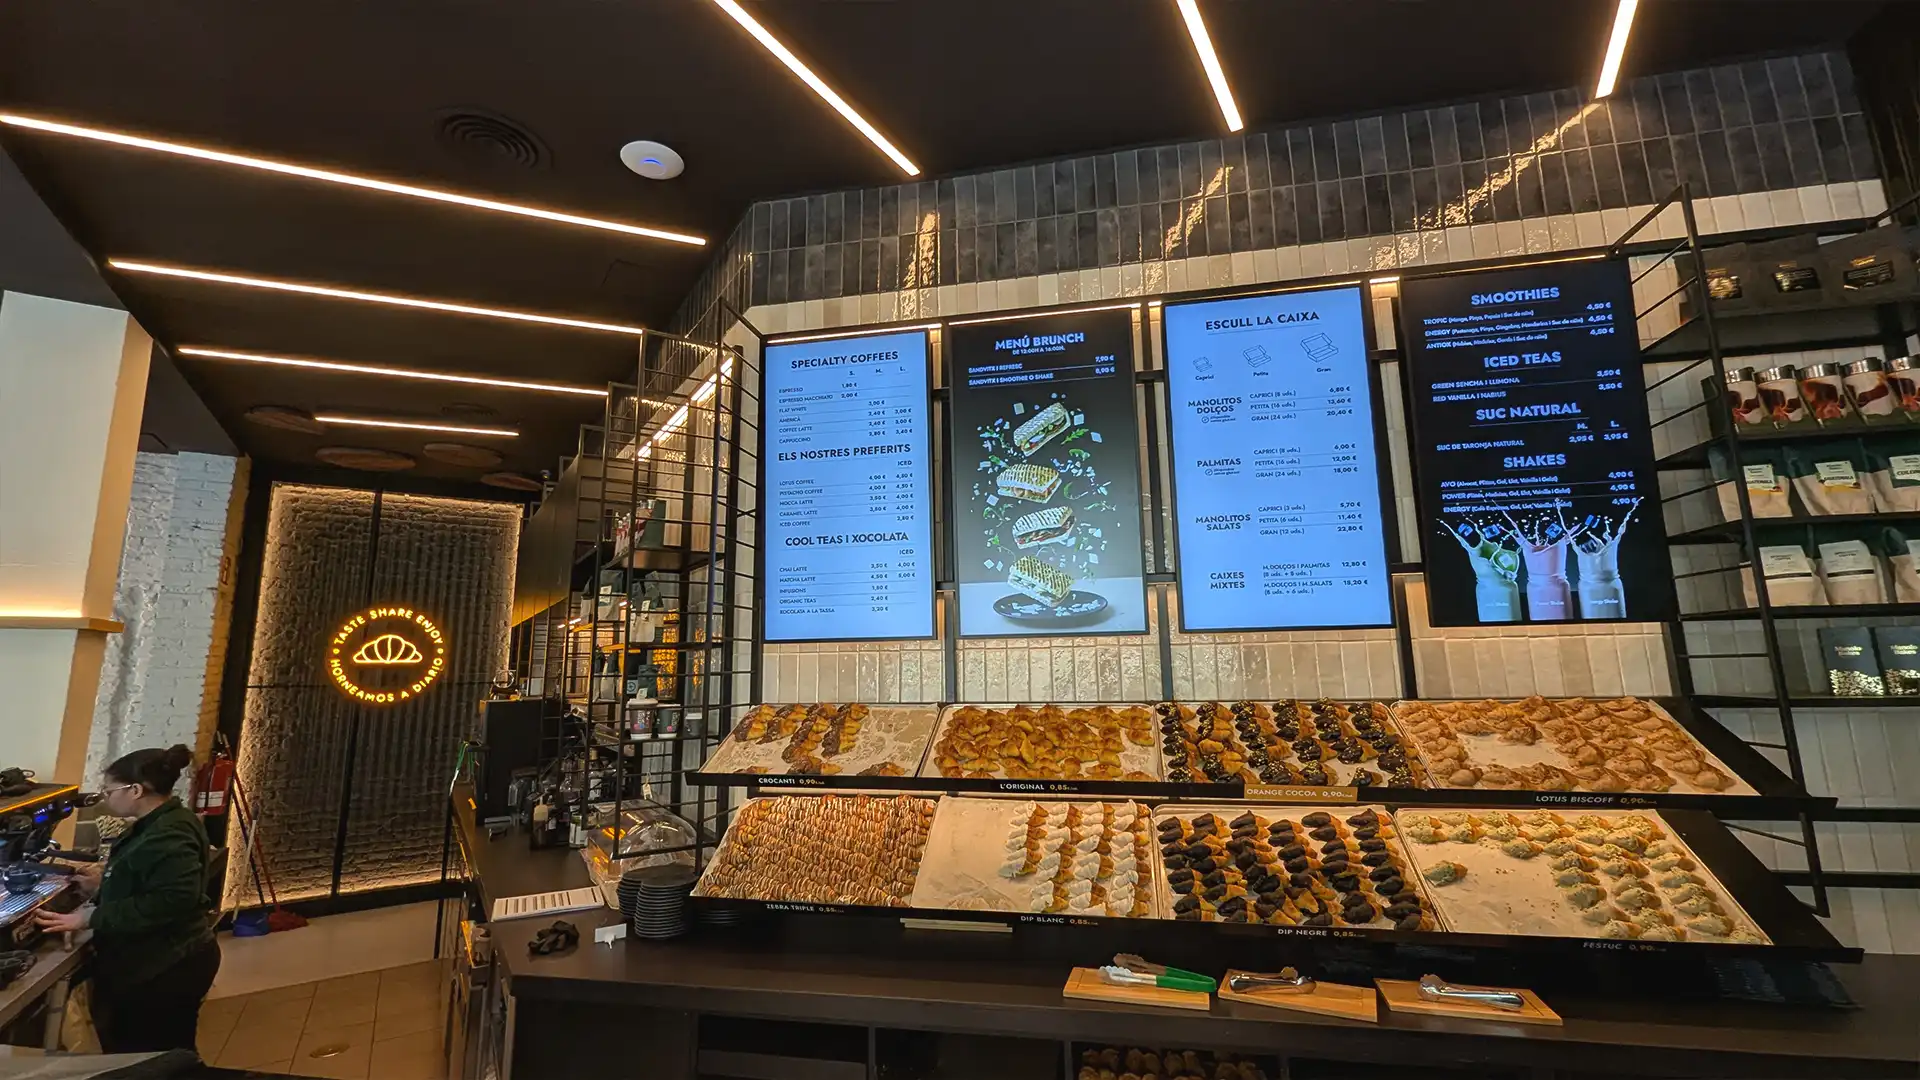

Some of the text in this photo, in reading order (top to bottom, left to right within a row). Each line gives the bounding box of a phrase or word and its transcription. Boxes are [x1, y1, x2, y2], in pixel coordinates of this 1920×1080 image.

[1471, 287, 1560, 305] SMOOTHIES
[1205, 311, 1320, 331] ESCULL LA CAIXA
[1424, 329, 1451, 337] ENERGY
[995, 332, 1085, 350] MENÚ BRUNCH
[791, 350, 899, 369] SPECIALTY COFFEES
[1484, 351, 1562, 368] ICED TEAS
[1188, 396, 1242, 407] MANOLITOS
[1447, 393, 1476, 401] VANILLA
[1197, 405, 1234, 415] DOLÇOS
[1476, 402, 1582, 420] SUC NATURAL
[778, 444, 911, 461] ELS NOSTRES PREFERITS
[1197, 458, 1241, 467] PALMITAS
[1503, 453, 1566, 468] SHAKES
[1195, 514, 1251, 523] MANOLITOS
[1206, 522, 1241, 531] SALATS
[785, 532, 909, 546] COOL TEAS I XOCOLATA
[1210, 572, 1245, 580] CAIXES
[1210, 581, 1245, 589] MIXTES
[334, 608, 443, 645] TASTE SHARE ENJOY
[330, 657, 443, 703] HORNEAMOS A DIARIO
[1570, 796, 1613, 804] BISCOFF
